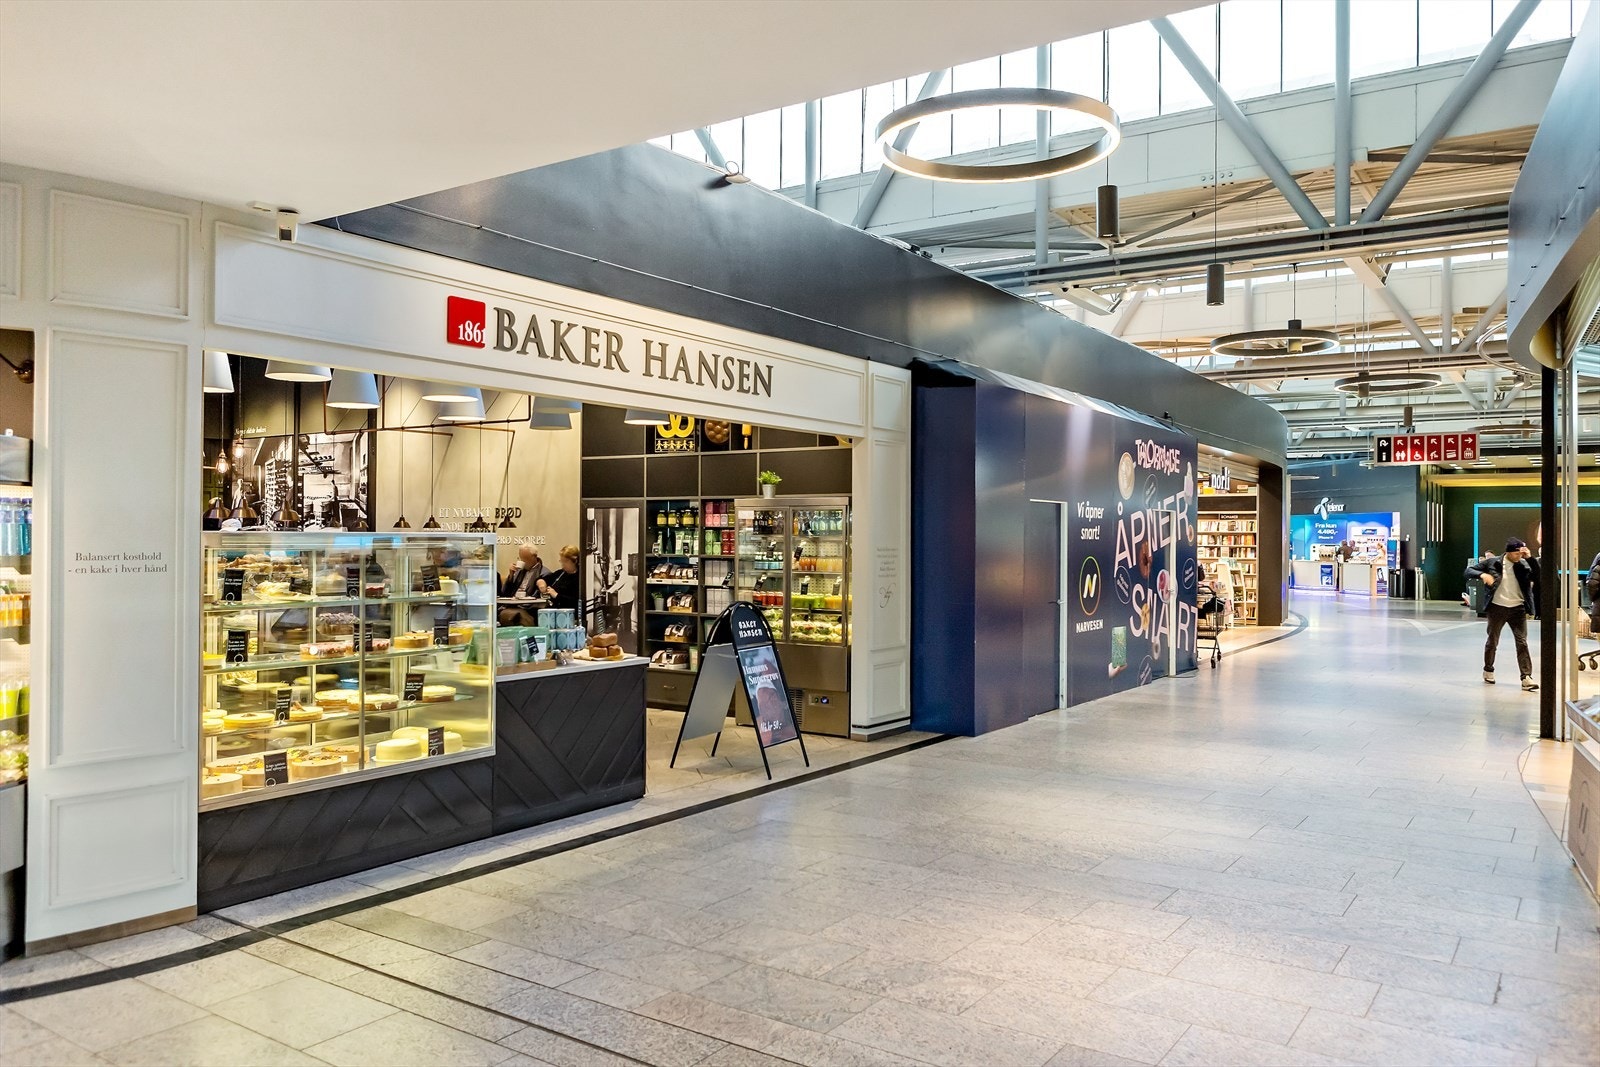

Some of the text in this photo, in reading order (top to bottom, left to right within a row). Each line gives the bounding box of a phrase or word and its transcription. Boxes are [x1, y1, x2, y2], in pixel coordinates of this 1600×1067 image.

[493, 306, 774, 398] BAKER HANSEN
[1211, 466, 1230, 490] norli
[439, 508, 450, 518] ET
[495, 507, 521, 519] BRØD
[1077, 501, 1104, 521] Vi åpner
[1327, 503, 1345, 512] telenor
[1081, 525, 1100, 540] snart!
[1114, 491, 1189, 578] ÅPNER
[75, 552, 162, 561] Balansert kosthold
[90, 565, 112, 573] kake
[121, 564, 141, 572] hver
[144, 564, 168, 572] hånd
[1130, 583, 1198, 653] SNART
[1076, 619, 1104, 633] NARVESEN
